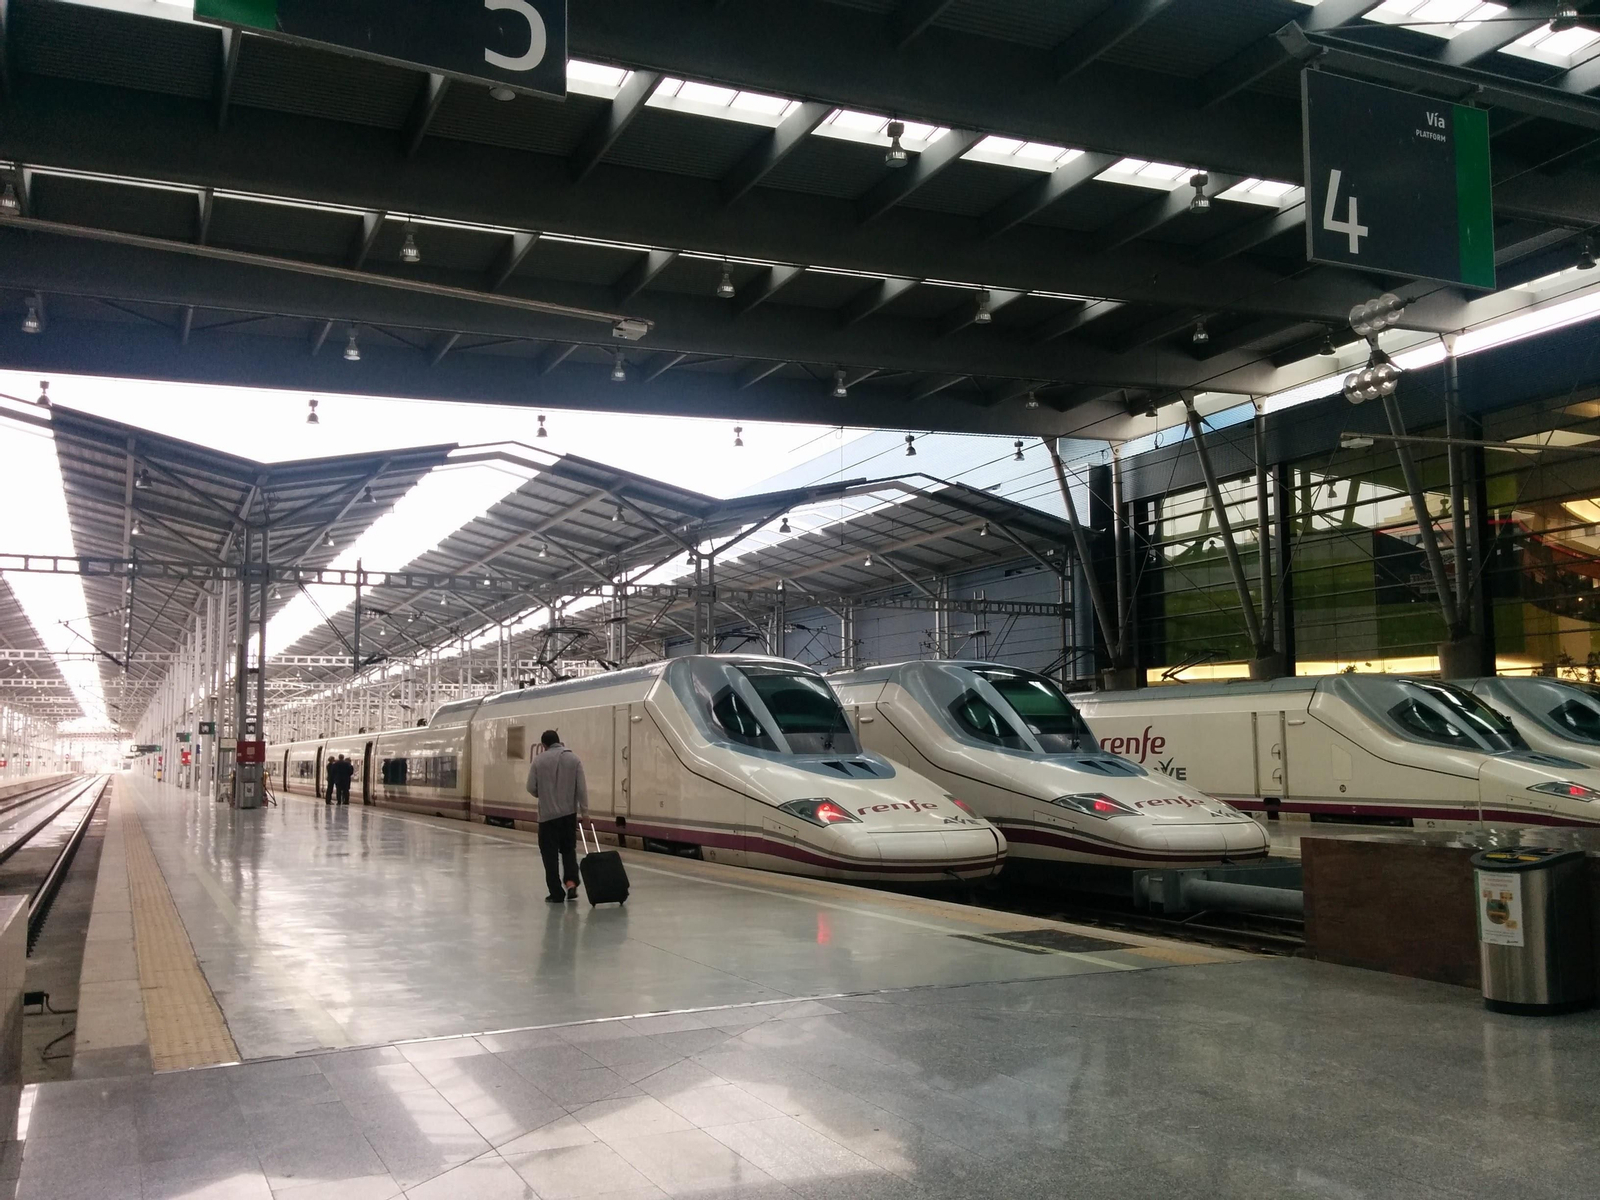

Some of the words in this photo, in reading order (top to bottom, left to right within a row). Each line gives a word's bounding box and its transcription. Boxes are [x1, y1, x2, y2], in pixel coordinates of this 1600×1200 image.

[1426, 111, 1446, 129] Vía
[1415, 129, 1446, 143] PLATFORM
[1323, 169, 1369, 255] 4
[1100, 725, 1166, 764] renfe
[857, 799, 939, 816] renfe
[1134, 795, 1206, 808] renfe
